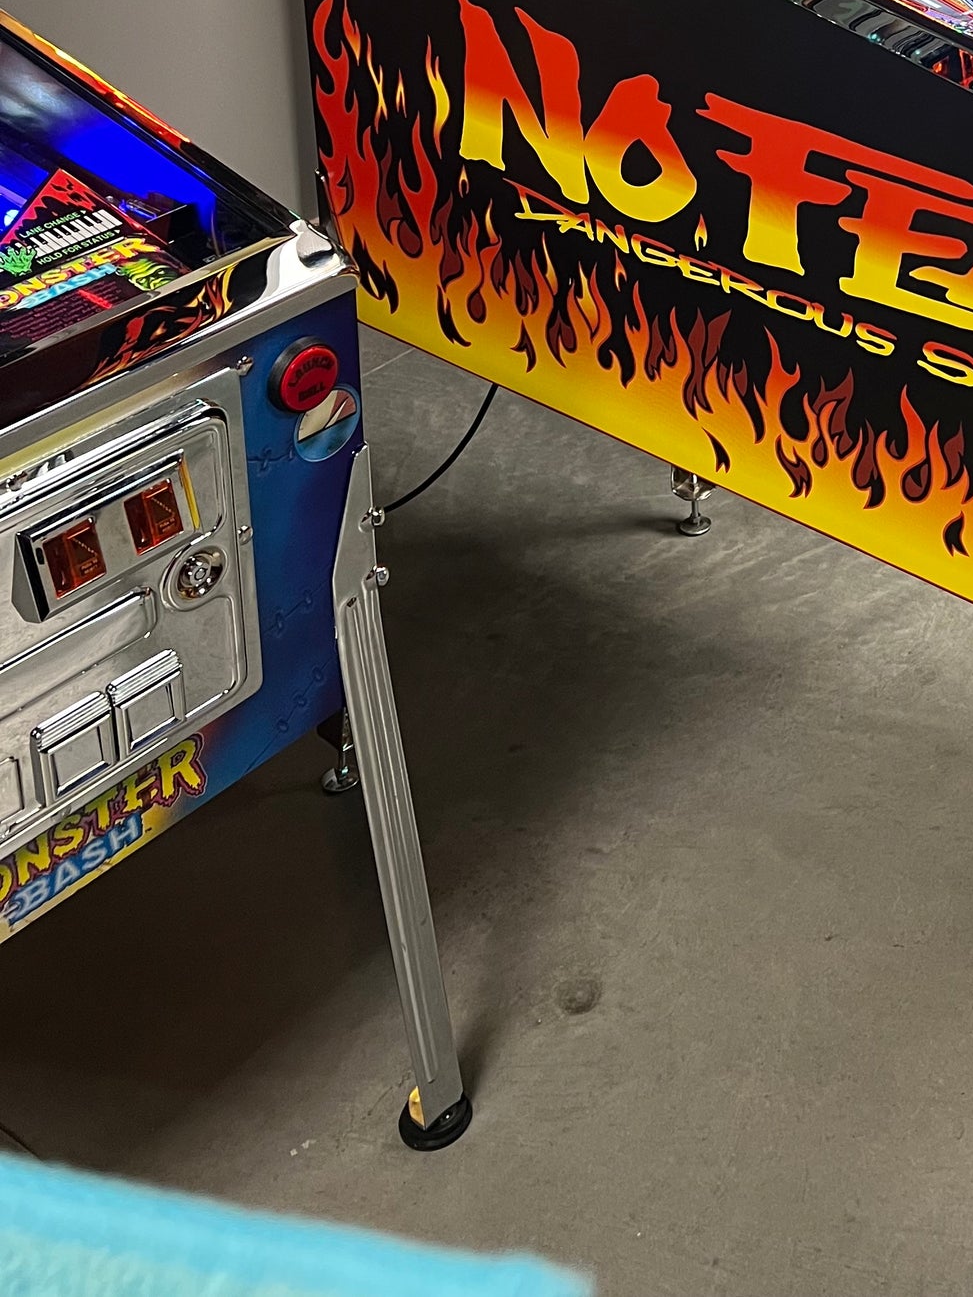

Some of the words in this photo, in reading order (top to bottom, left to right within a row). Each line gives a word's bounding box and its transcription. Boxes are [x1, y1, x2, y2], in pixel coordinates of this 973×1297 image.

[19, 225, 44, 239] LANE
[44, 211, 80, 231] CHANGE
[37, 251, 63, 266] HOLD
[64, 243, 81, 255] FOR
[81, 231, 116, 249] STATUS
[0, 237, 160, 308] ONSTER
[14, 262, 117, 308] BASH
[503, 178, 896, 357] DANGEROUS
[12, 815, 143, 919] BASH
